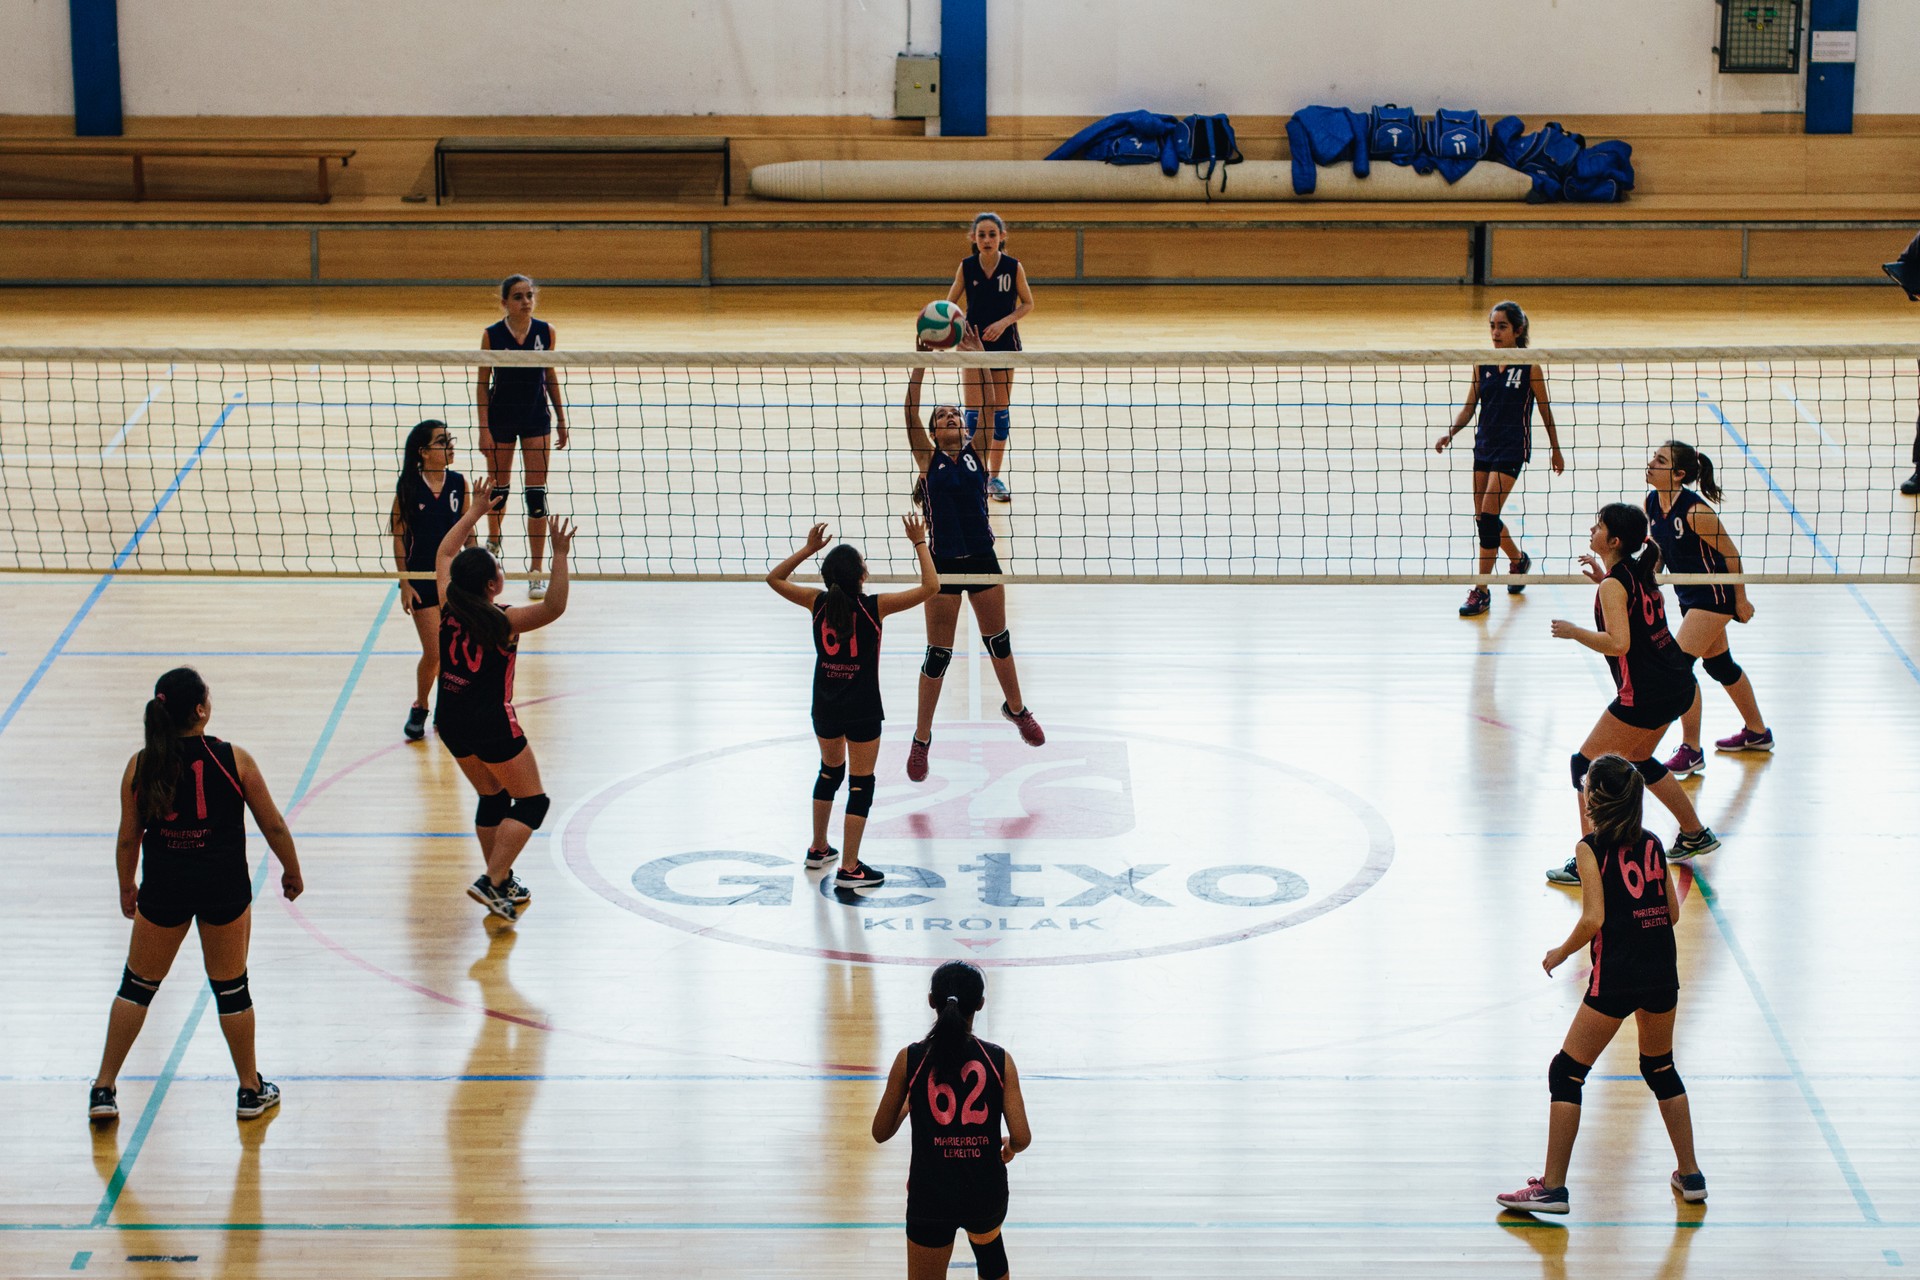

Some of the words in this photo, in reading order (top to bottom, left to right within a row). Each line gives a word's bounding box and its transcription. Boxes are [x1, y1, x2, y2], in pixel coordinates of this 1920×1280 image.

[1454, 141, 1466, 155] 11
[997, 273, 1011, 292] 10
[534, 334, 544, 351] 4
[1505, 367, 1522, 389] 14
[963, 453, 977, 472] 8
[449, 490, 459, 513] 6
[1674, 516, 1684, 539] 9
[821, 611, 858, 658] 61
[631, 850, 1309, 908] Getxo
[1618, 839, 1664, 899] 64
[864, 917, 1104, 930] KIROLAK
[927, 1060, 989, 1126] 62
[934, 1136, 989, 1146] MARIERROTA
[944, 1148, 981, 1158] LEKEITIO
